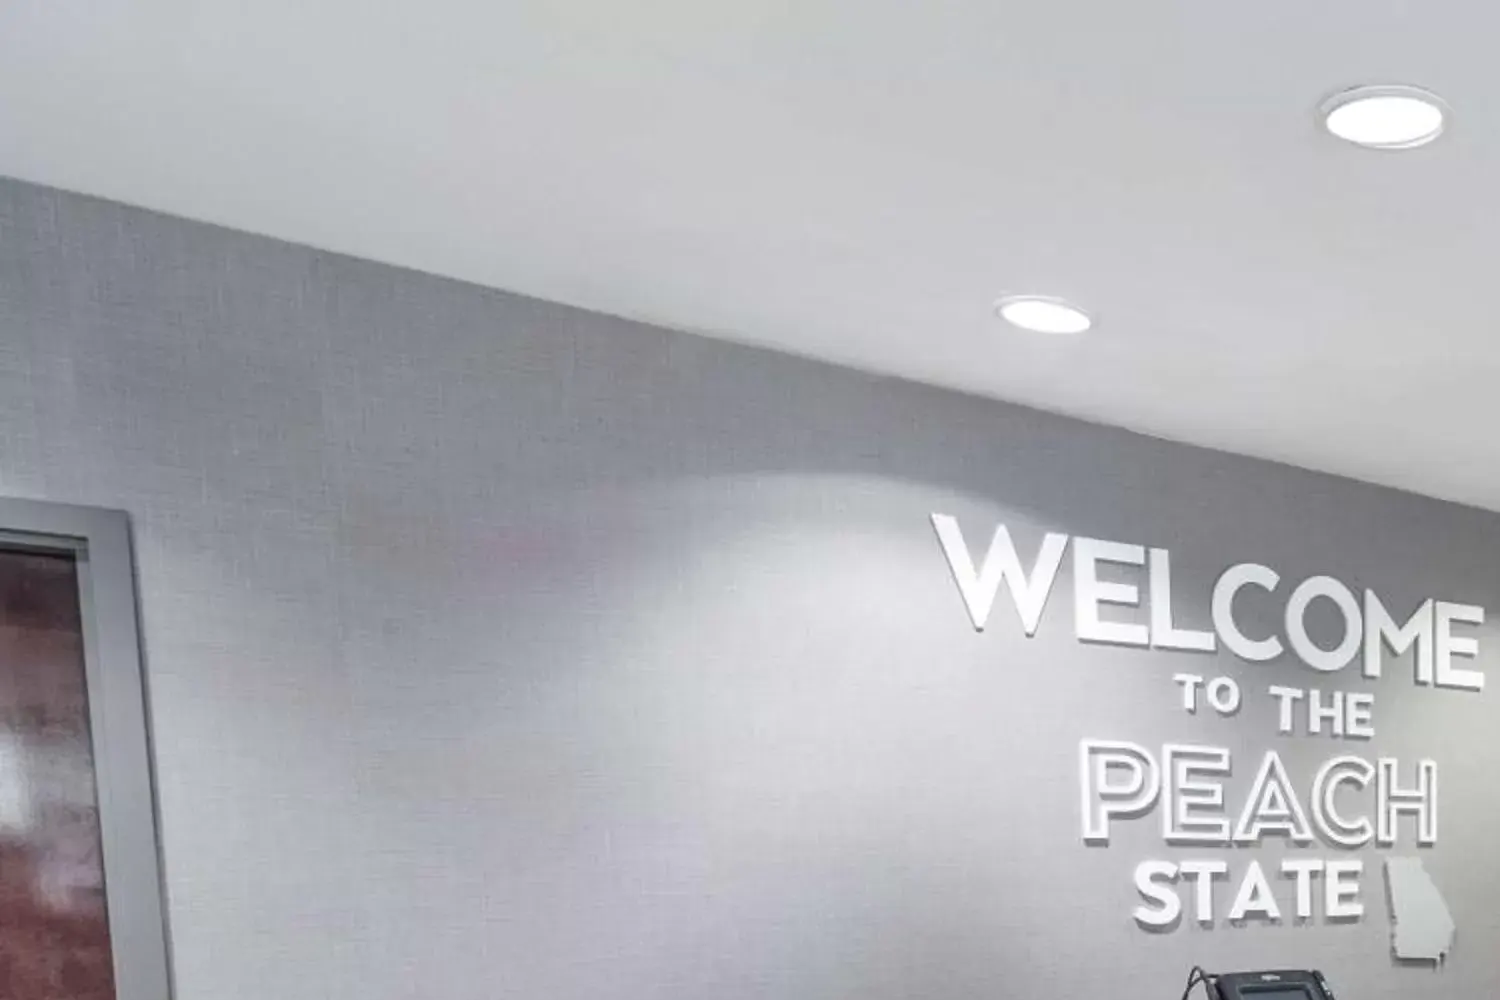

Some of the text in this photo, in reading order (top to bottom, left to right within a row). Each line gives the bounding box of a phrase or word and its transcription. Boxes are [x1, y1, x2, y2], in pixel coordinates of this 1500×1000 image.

[930, 512, 1486, 689] WELCOME
[1174, 673, 1375, 738] TO THE
[1079, 738, 1438, 847] PEACH
[1133, 859, 1364, 930] STATE
